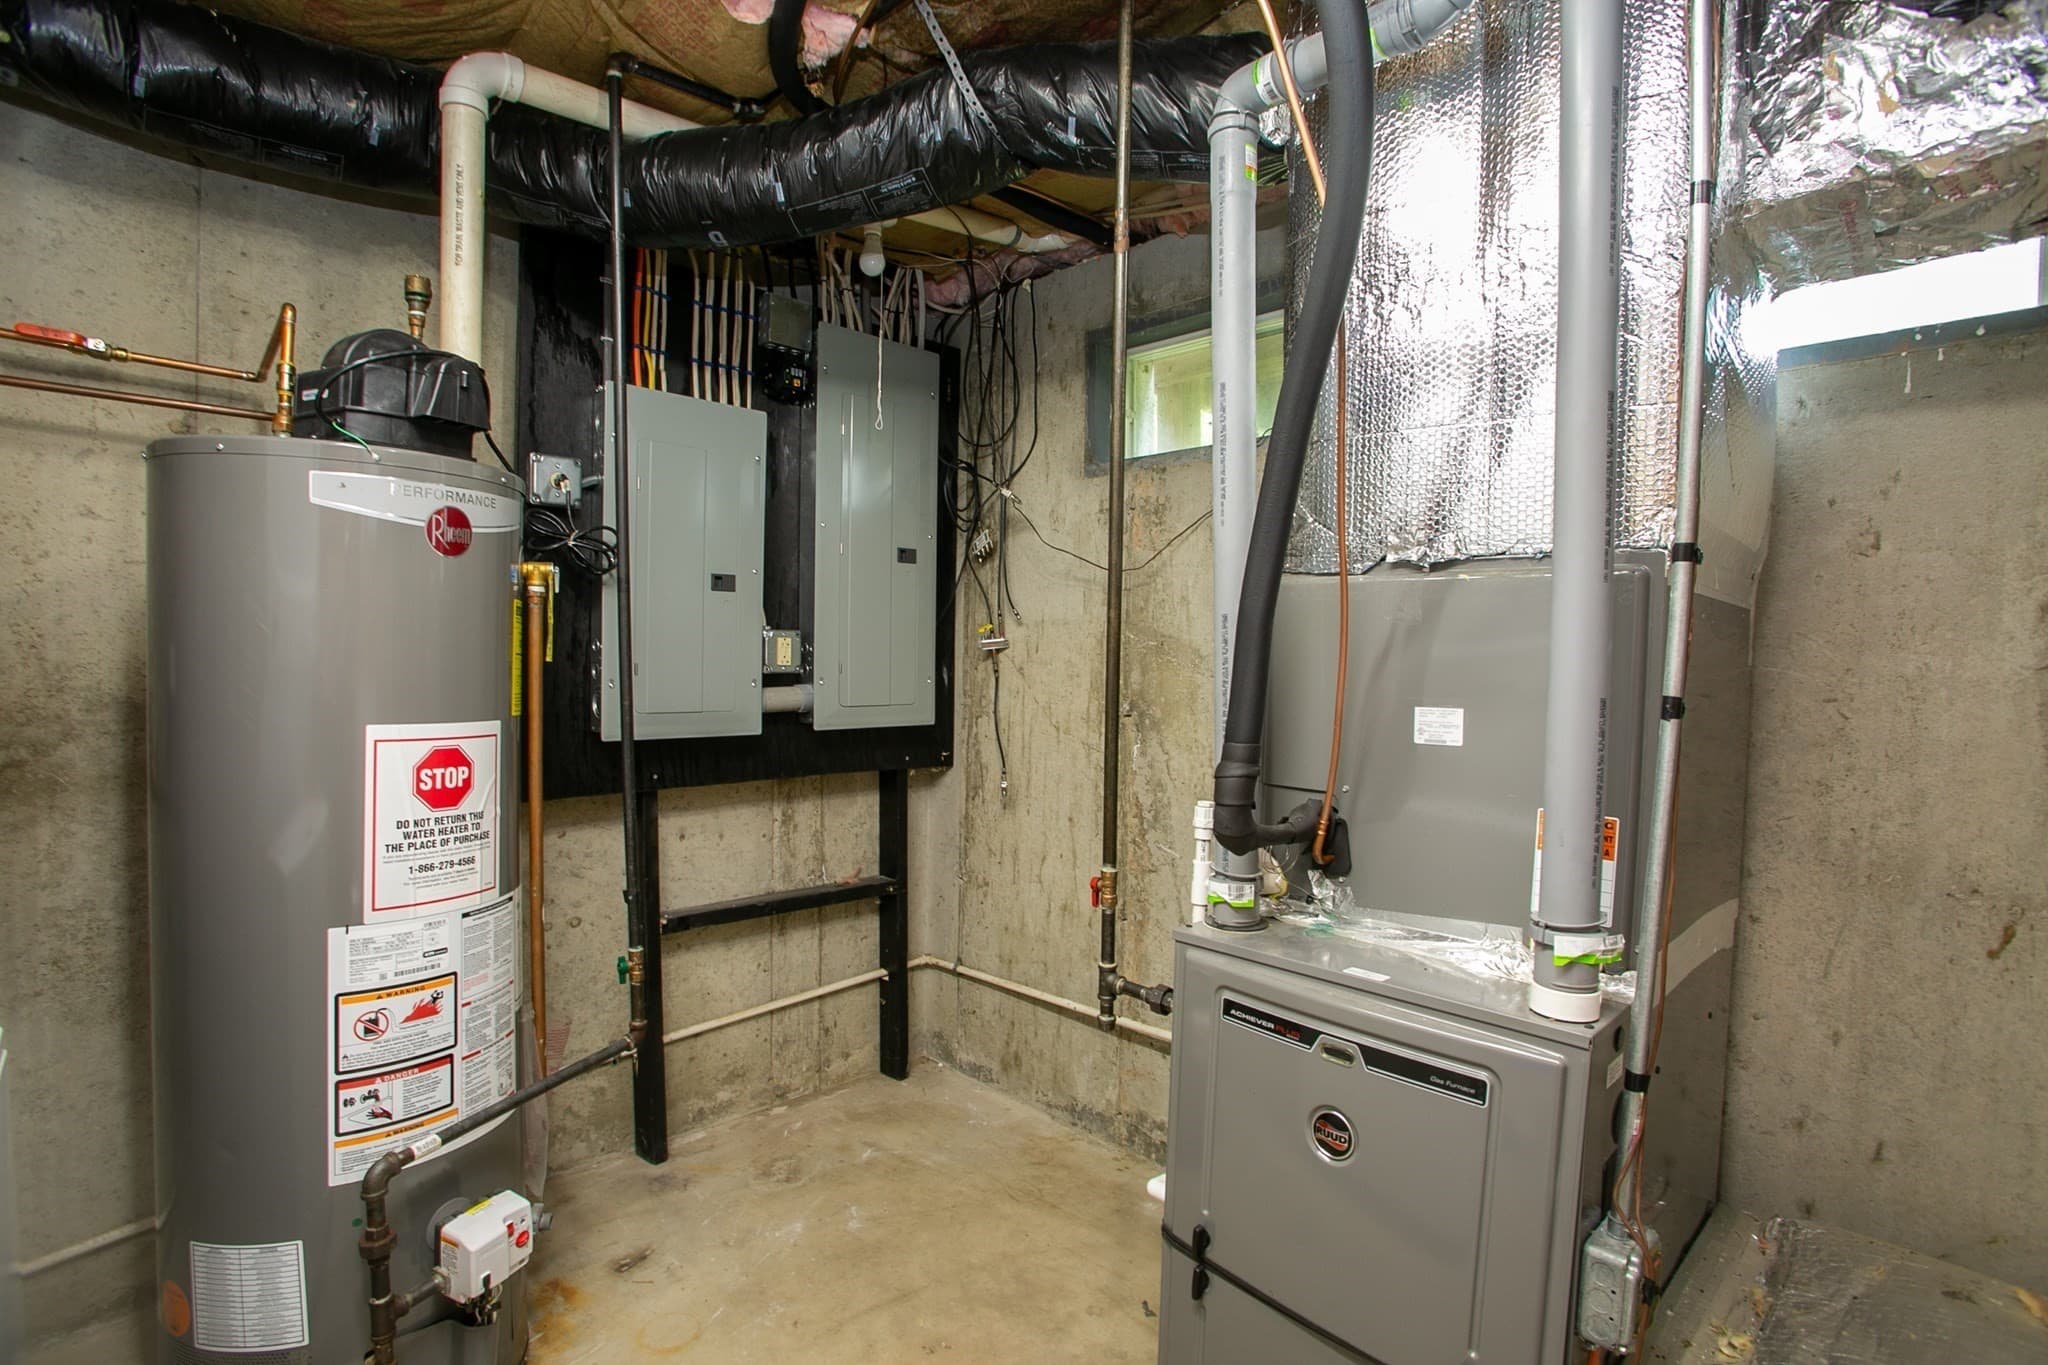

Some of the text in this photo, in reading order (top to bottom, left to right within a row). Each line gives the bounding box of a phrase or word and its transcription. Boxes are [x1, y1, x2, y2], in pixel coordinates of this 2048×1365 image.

[455, 212, 464, 233] WASTE
[391, 483, 497, 509] PERFORMANCE
[431, 506, 472, 550] Rheem
[419, 766, 469, 790] STOP
[396, 810, 485, 830] DO NOT RETURN THIS
[403, 821, 481, 841] WATER HEATER TO
[385, 830, 491, 854] THE PLACE OF PURCHASE
[386, 984, 427, 998] WARNING
[1230, 1009, 1275, 1029] ACHIEVER
[384, 1068, 420, 1082] DANGER
[1446, 1080, 1476, 1094] Furnace
[1316, 1125, 1349, 1146] RUUD
